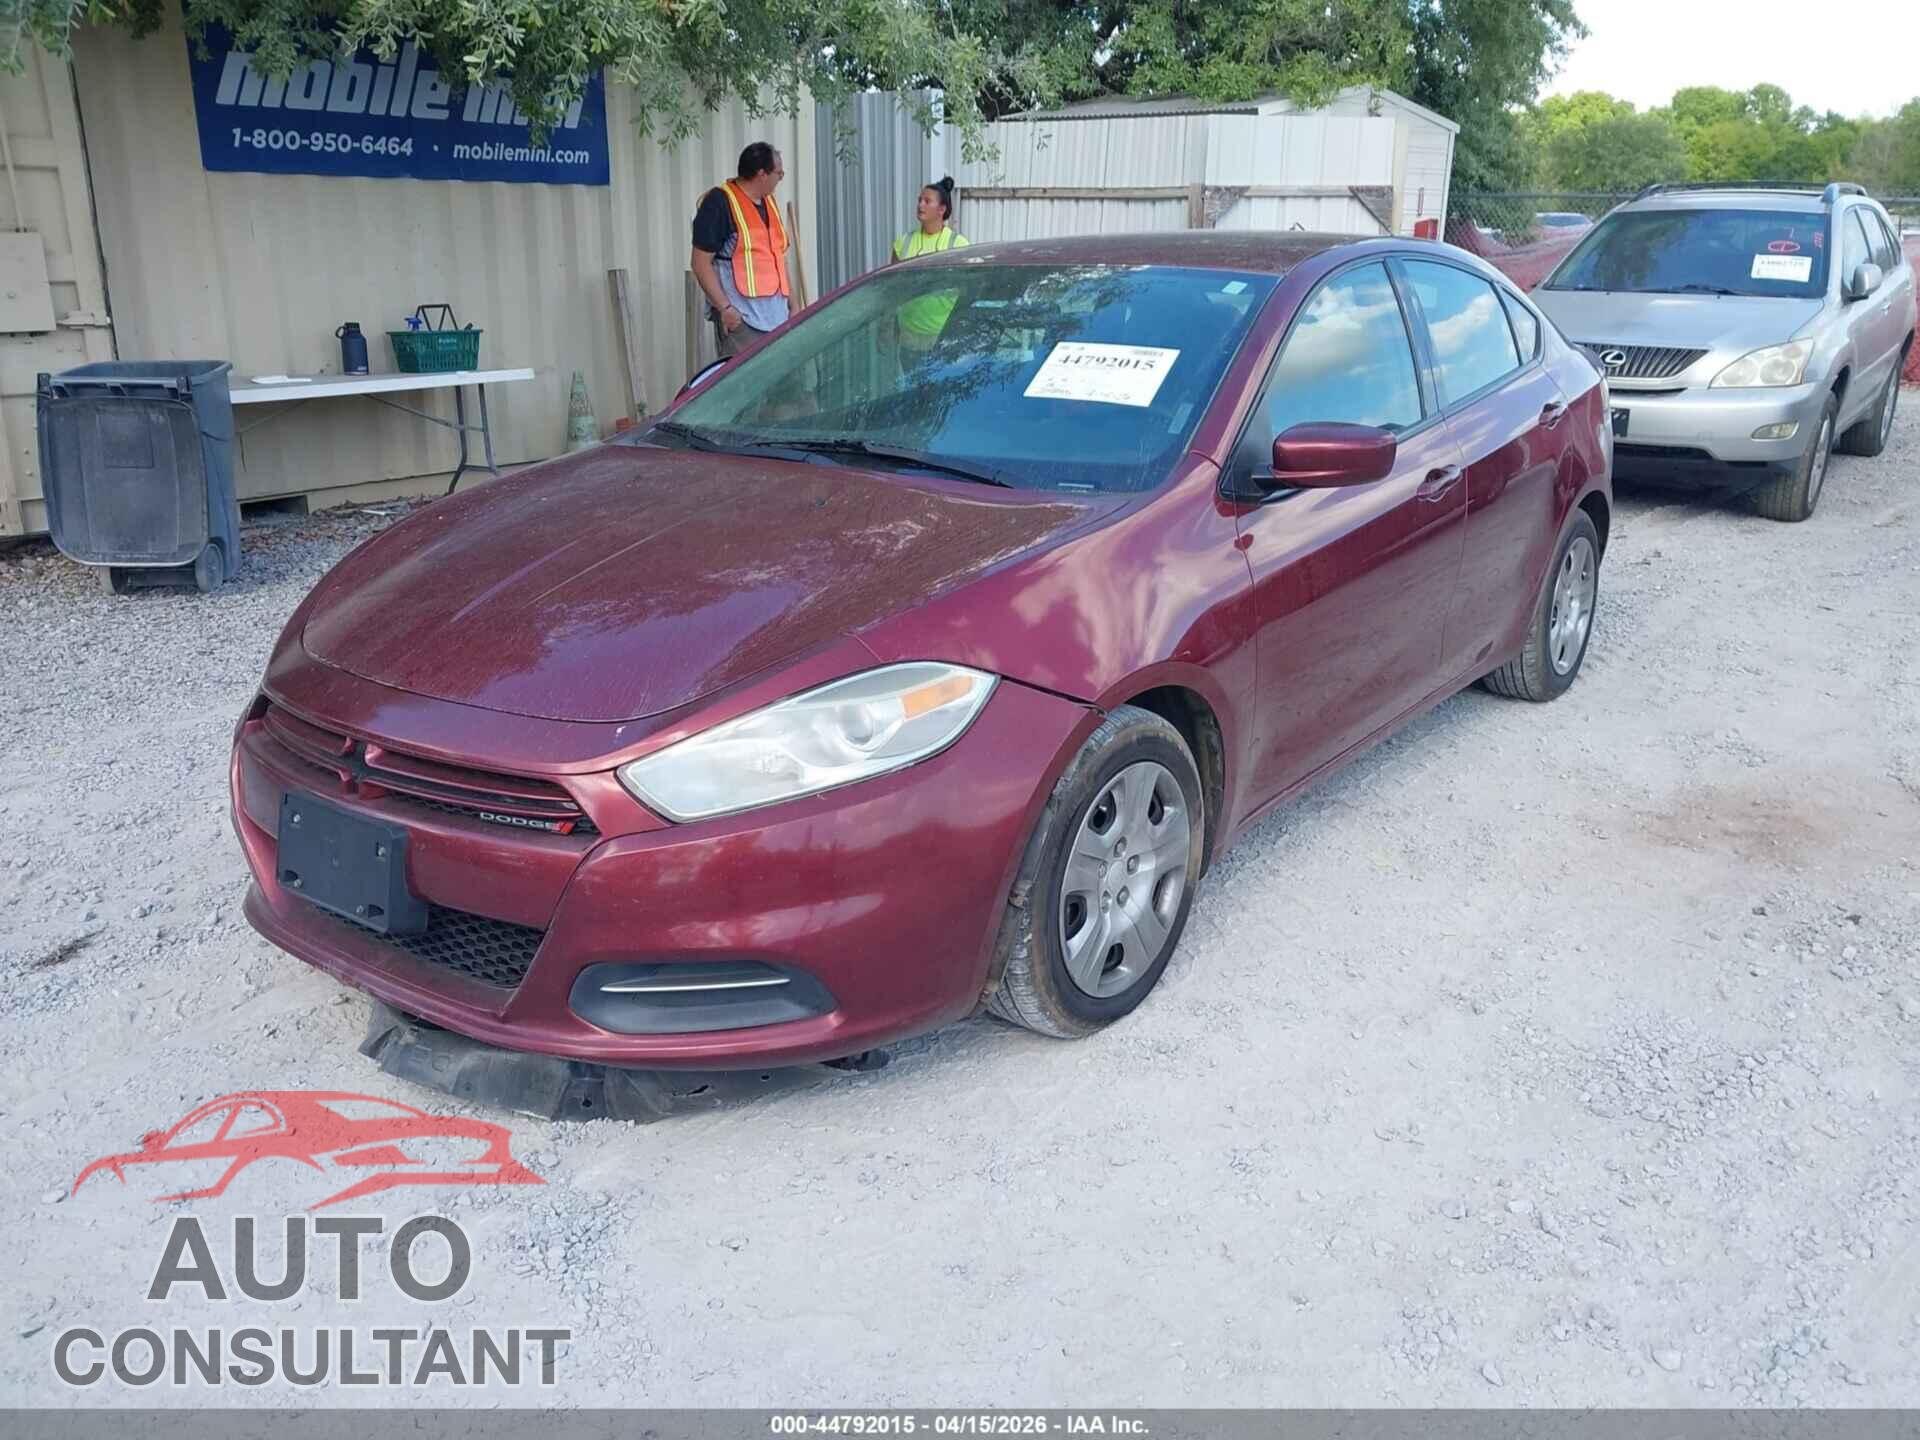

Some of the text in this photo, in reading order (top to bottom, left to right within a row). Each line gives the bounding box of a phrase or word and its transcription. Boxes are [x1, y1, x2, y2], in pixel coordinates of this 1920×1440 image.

[215, 40, 450, 120] mobile
[232, 127, 590, 165] 1-800-950-6464 mobilemini.com
[1058, 353, 1156, 370] 44792015
[480, 811, 560, 831] DODGE
